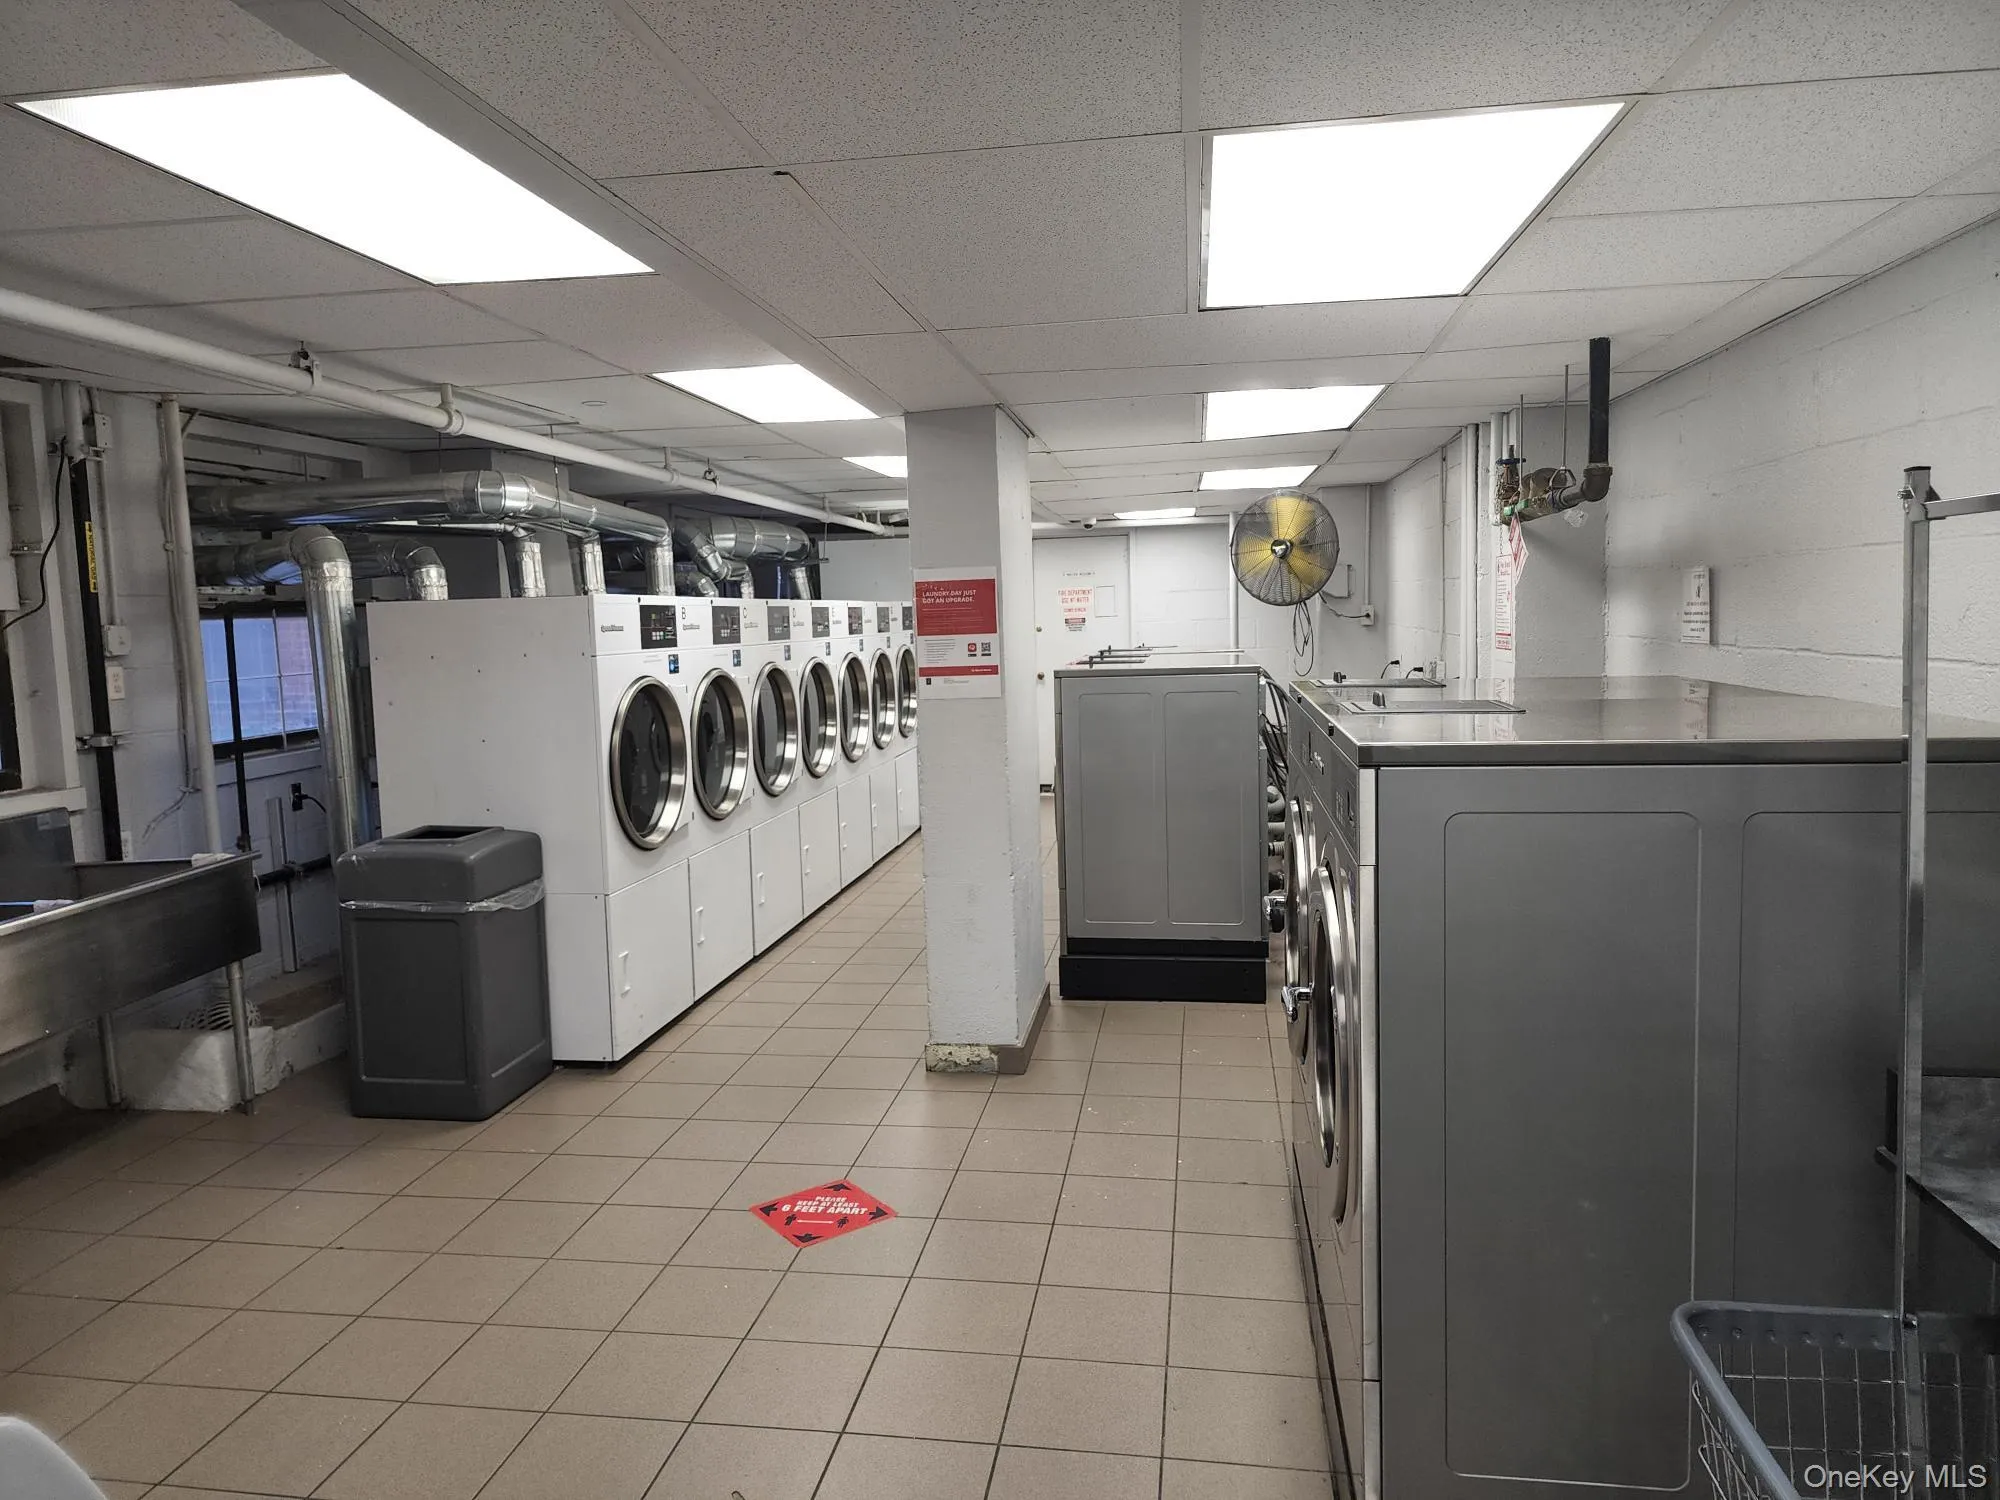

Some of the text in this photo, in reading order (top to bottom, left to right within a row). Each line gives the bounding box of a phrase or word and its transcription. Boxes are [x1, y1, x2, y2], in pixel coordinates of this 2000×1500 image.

[946, 596, 975, 604] UPGRADE.
[781, 1204, 869, 1215] 6 FEET APART
